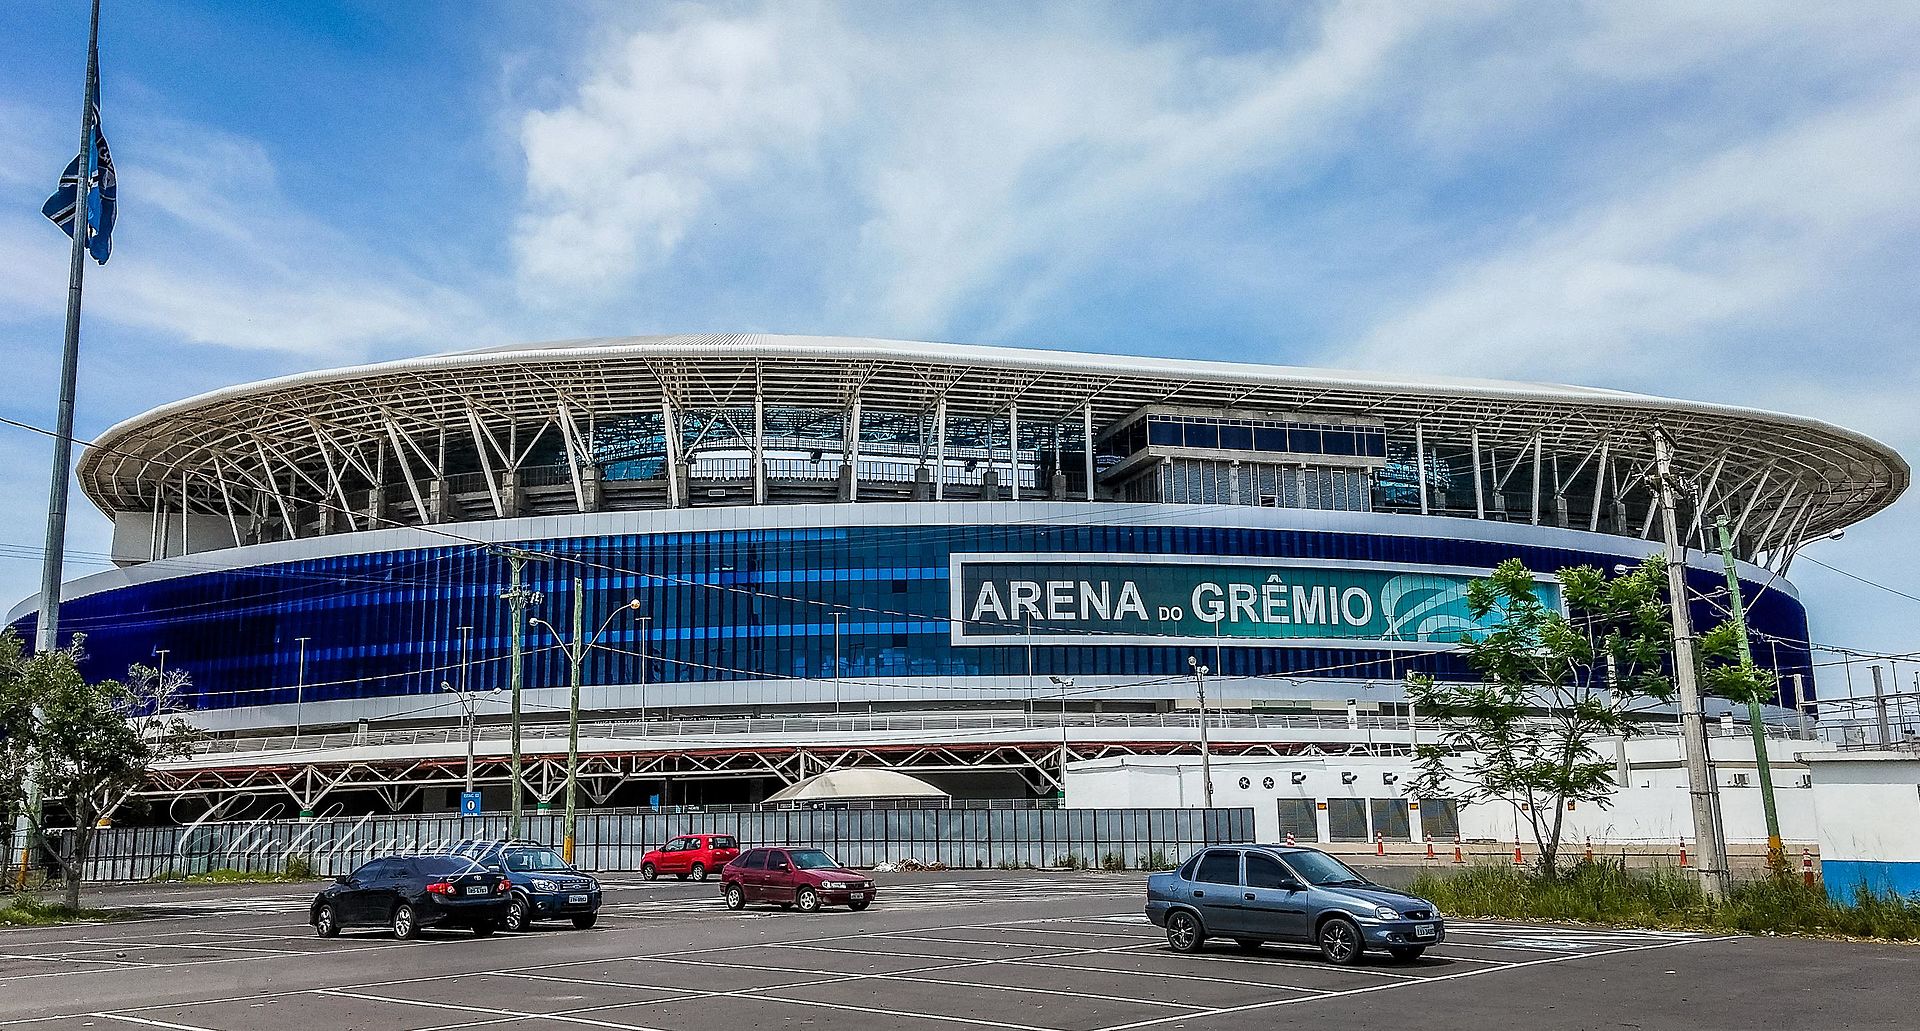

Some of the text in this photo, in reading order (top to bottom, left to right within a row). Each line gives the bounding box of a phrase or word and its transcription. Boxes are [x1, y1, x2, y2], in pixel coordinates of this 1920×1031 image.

[971, 574, 1373, 626] ARENA DO GRÊMIO
